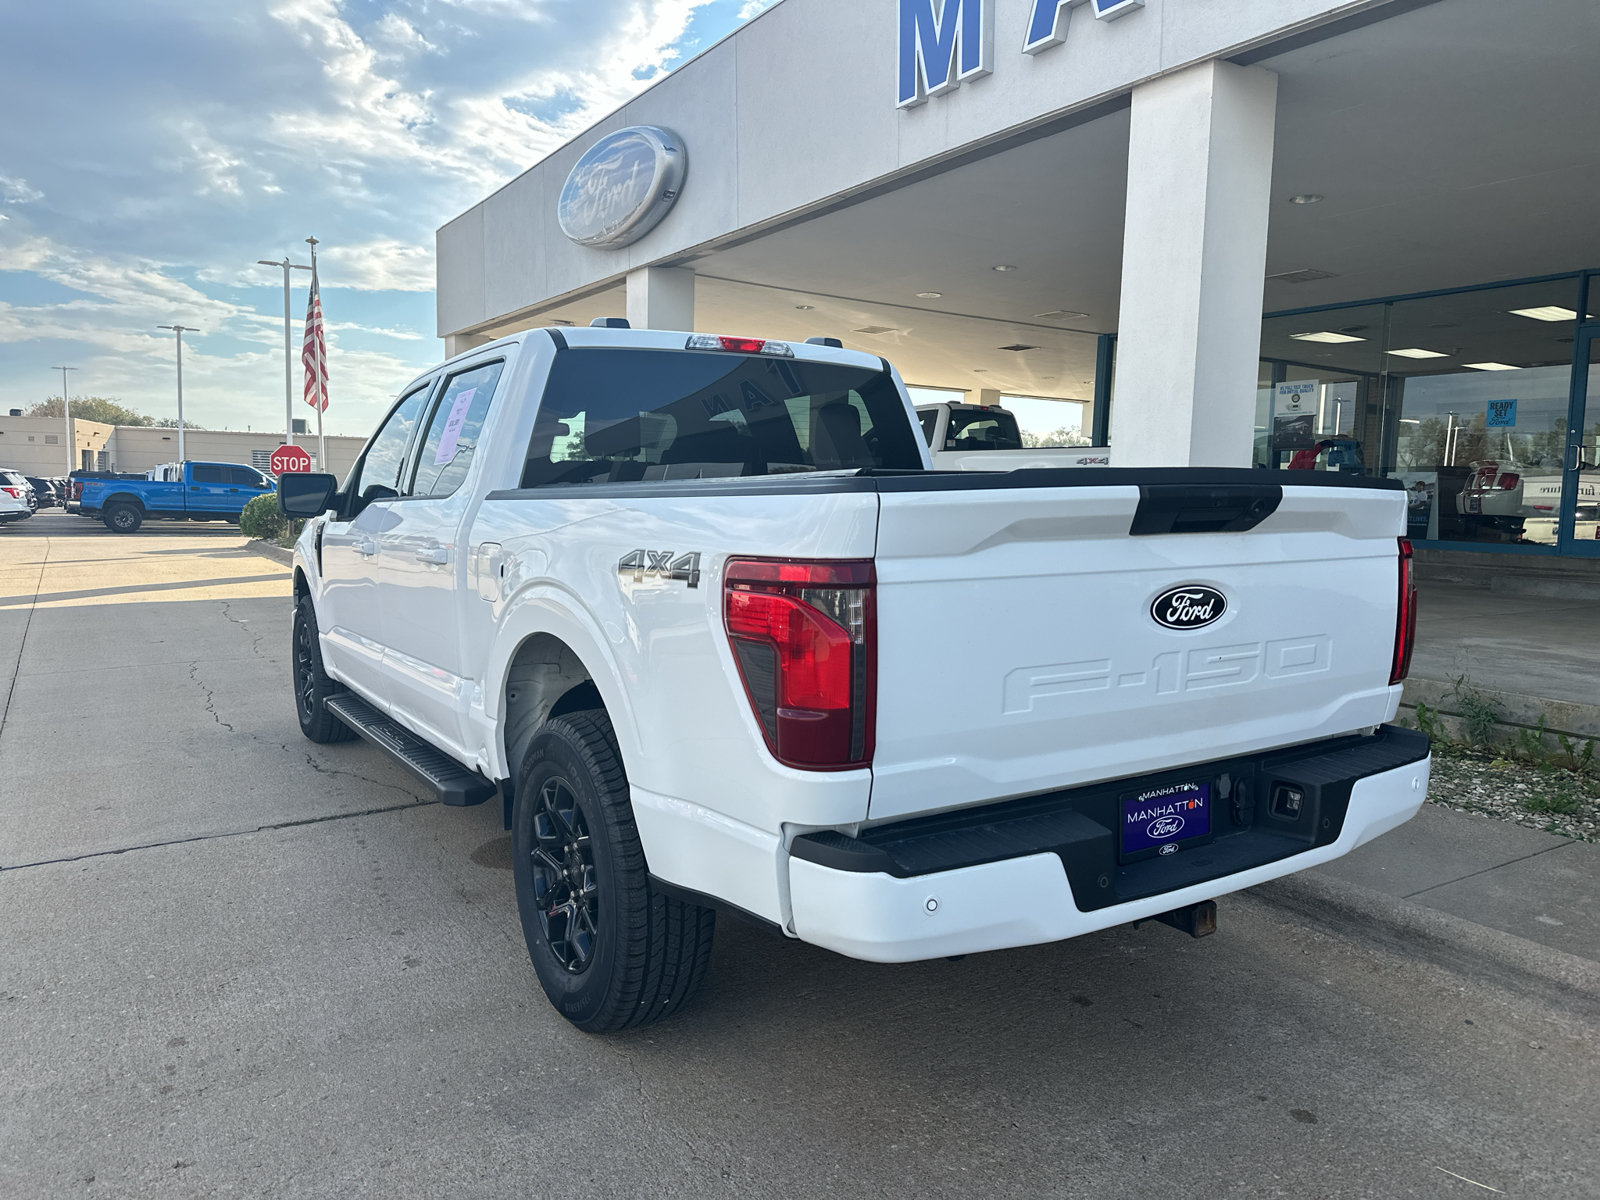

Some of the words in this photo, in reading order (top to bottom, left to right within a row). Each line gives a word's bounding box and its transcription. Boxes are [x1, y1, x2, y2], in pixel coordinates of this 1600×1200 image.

[580, 154, 640, 226] Ford
[1490, 401, 1513, 410] READY
[1494, 409, 1507, 417] SET
[273, 456, 309, 471] STOP
[1166, 593, 1215, 622] Ford
[1002, 633, 1333, 715] F-150
[1153, 818, 1179, 836] Ford
[1162, 845, 1176, 854] Ford
